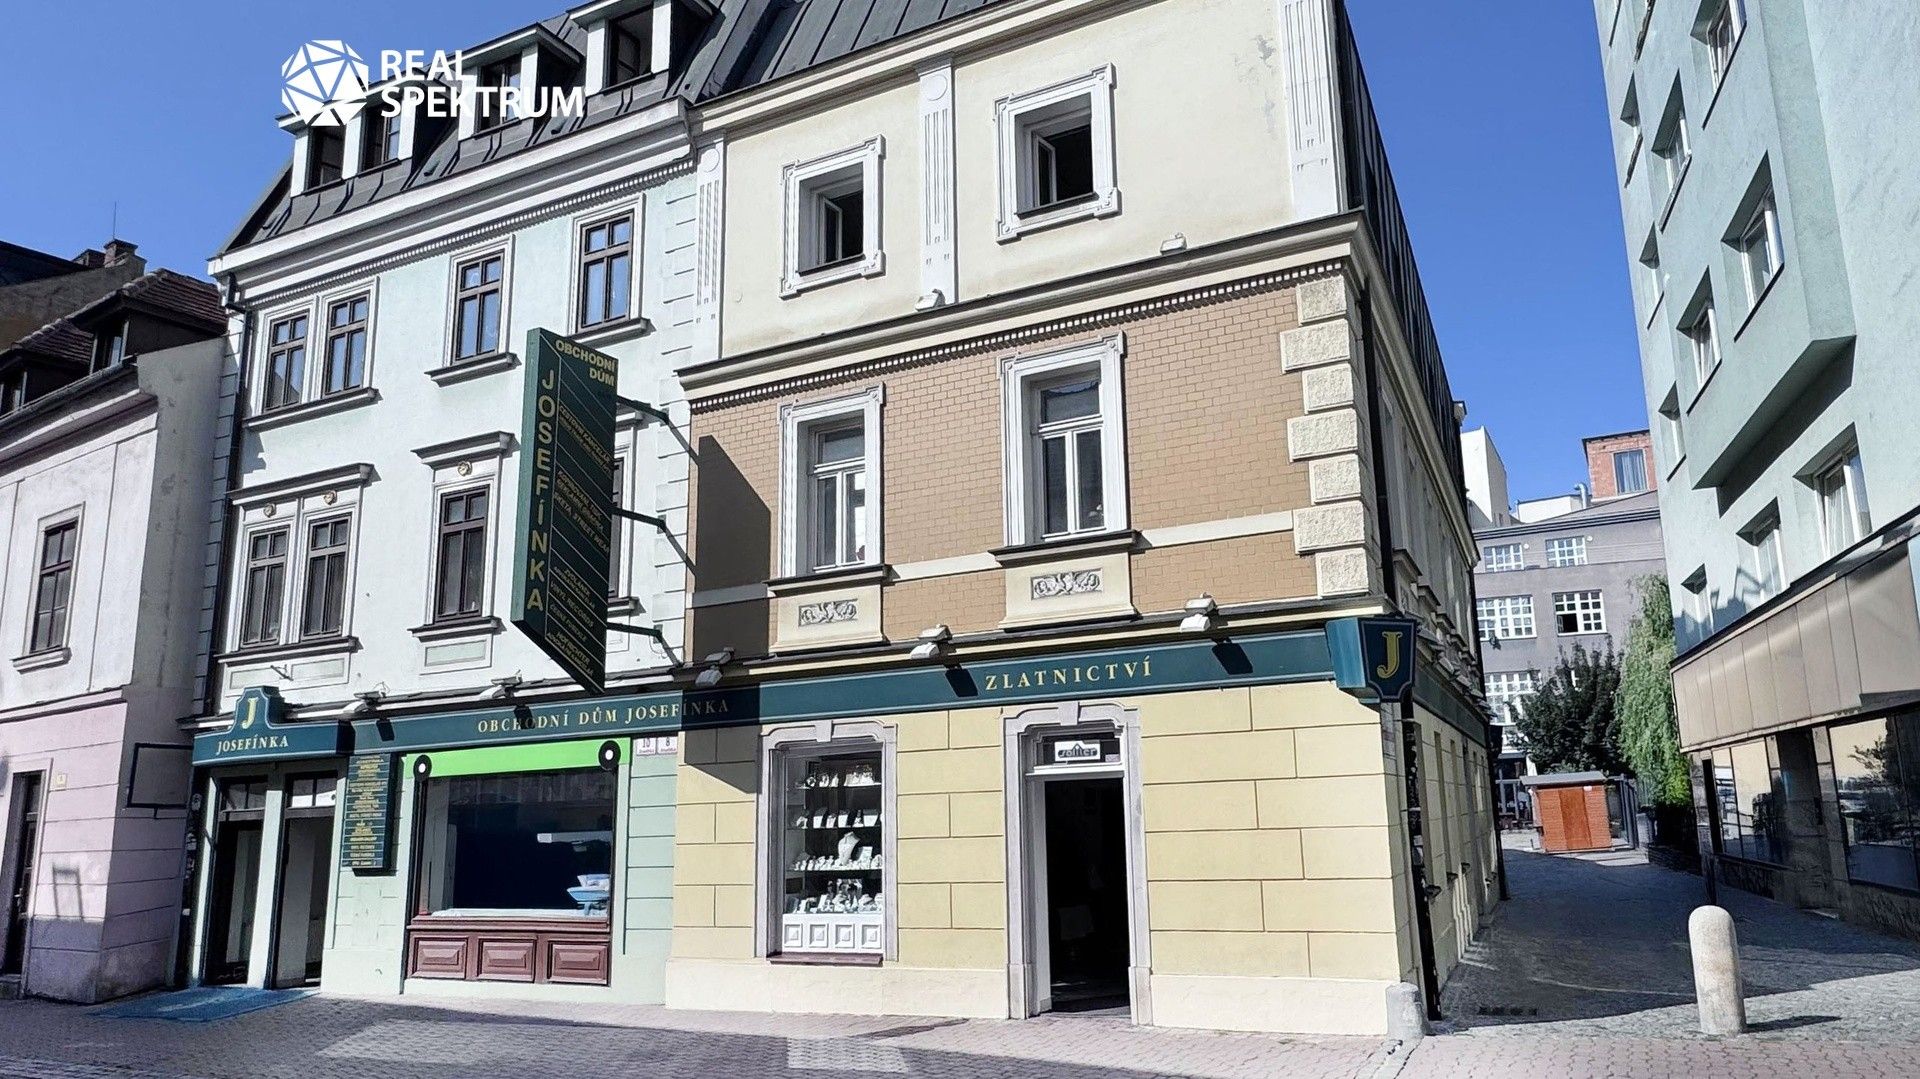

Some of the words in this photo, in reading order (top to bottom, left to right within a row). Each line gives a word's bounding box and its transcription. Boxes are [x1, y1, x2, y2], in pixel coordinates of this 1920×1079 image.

[555, 339, 616, 373] OBCHODNÍ
[1376, 630, 1403, 679] J
[984, 655, 1153, 691] ZLATNICTVÍ
[241, 697, 259, 730] J
[578, 705, 618, 726] DŮM
[624, 698, 729, 725] JOSEFÍNKA
[216, 734, 290, 756] JOSEFÍNKA
